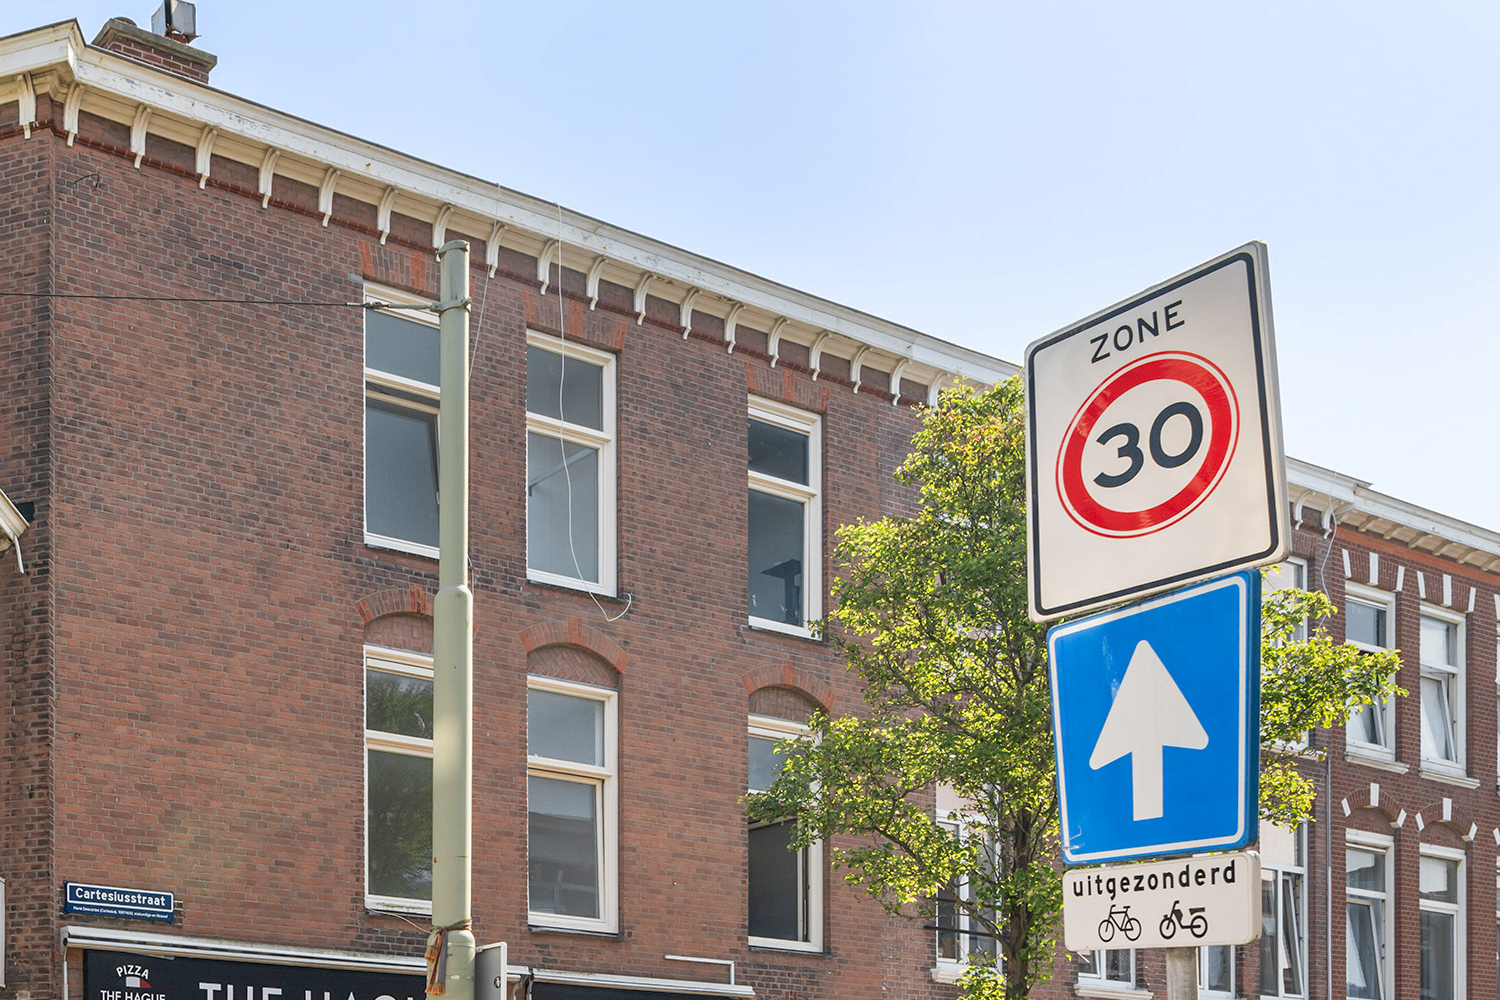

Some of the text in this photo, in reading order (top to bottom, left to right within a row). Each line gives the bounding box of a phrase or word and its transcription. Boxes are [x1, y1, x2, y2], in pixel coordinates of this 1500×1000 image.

[1090, 300, 1185, 364] ZONE
[1093, 401, 1204, 488] 30
[75, 887, 166, 906] Cartesiusstraat
[1073, 859, 1236, 901] uitgezonderd
[115, 964, 150, 980] PIZZA
